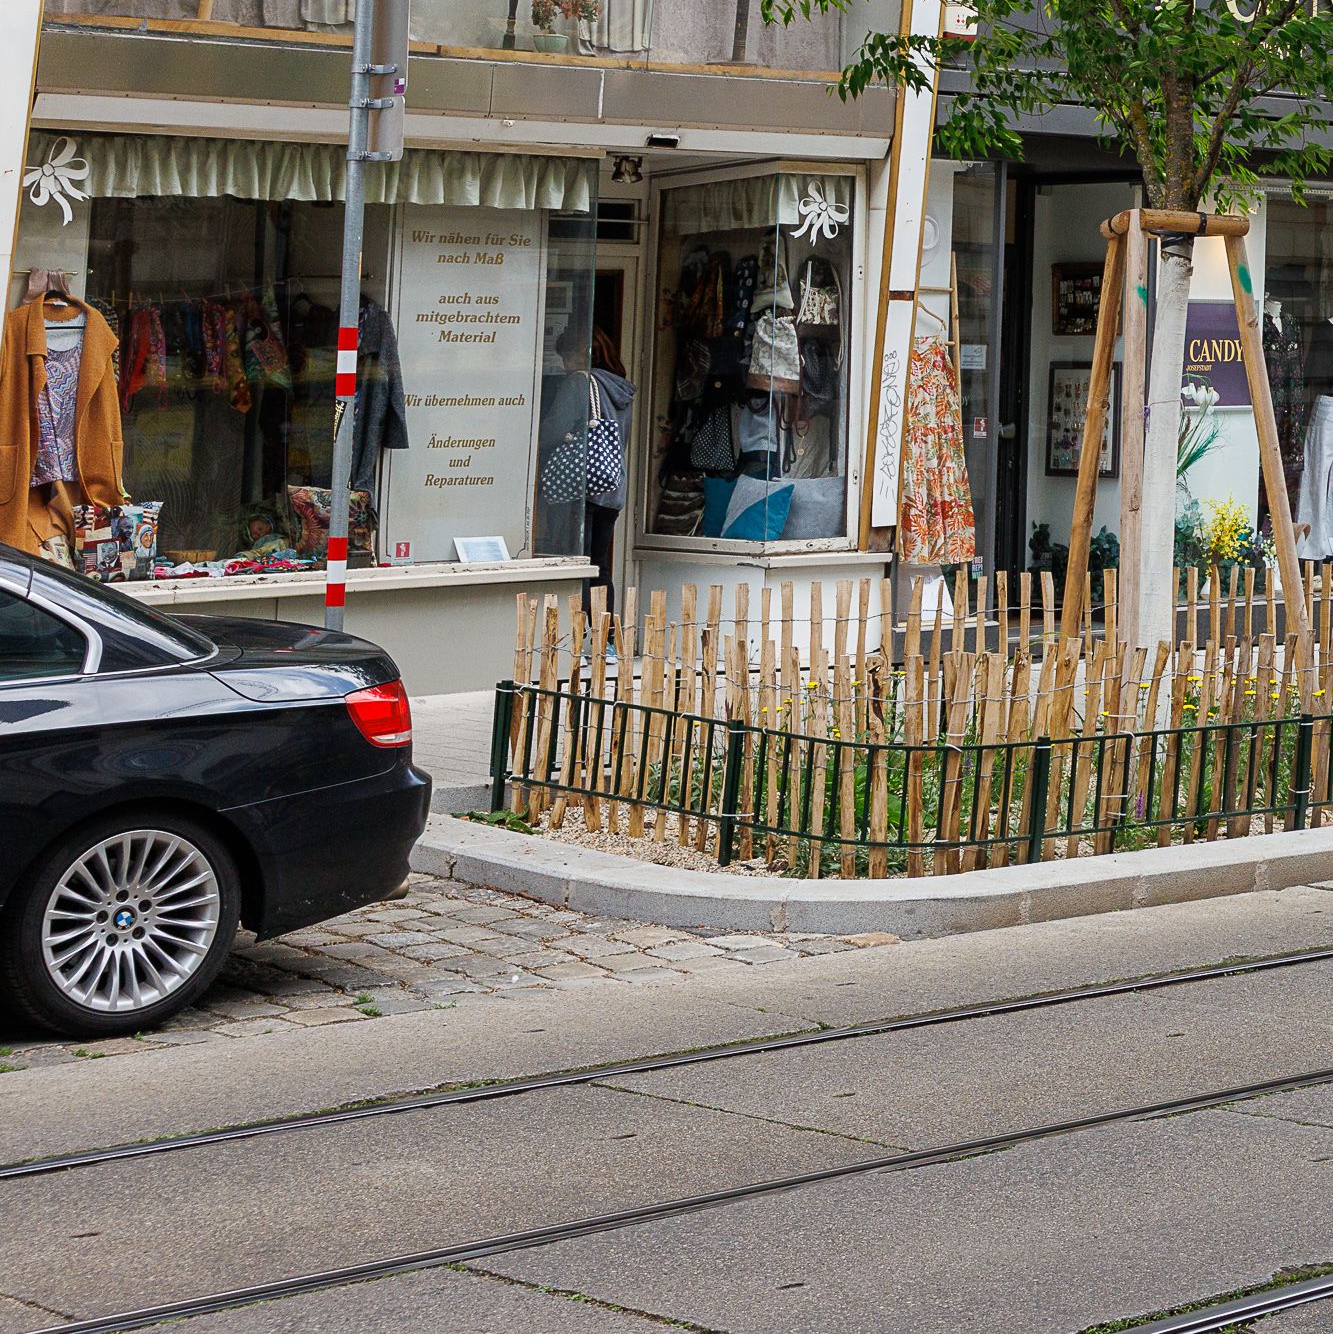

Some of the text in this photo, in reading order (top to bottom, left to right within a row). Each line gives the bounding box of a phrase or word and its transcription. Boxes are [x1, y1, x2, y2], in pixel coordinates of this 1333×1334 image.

[411, 230, 531, 247] Wir nähen für Sie
[437, 252, 505, 265] nach Maß
[438, 292, 500, 305] auch aus
[415, 311, 521, 325] mitgebrachtem
[438, 330, 497, 343] Material
[1189, 339, 1244, 362] CANDY
[404, 394, 525, 407] Wir übernehmen auch
[427, 433, 496, 450] Änderungen
[448, 455, 472, 467] und
[424, 474, 495, 488] Reparaturen
